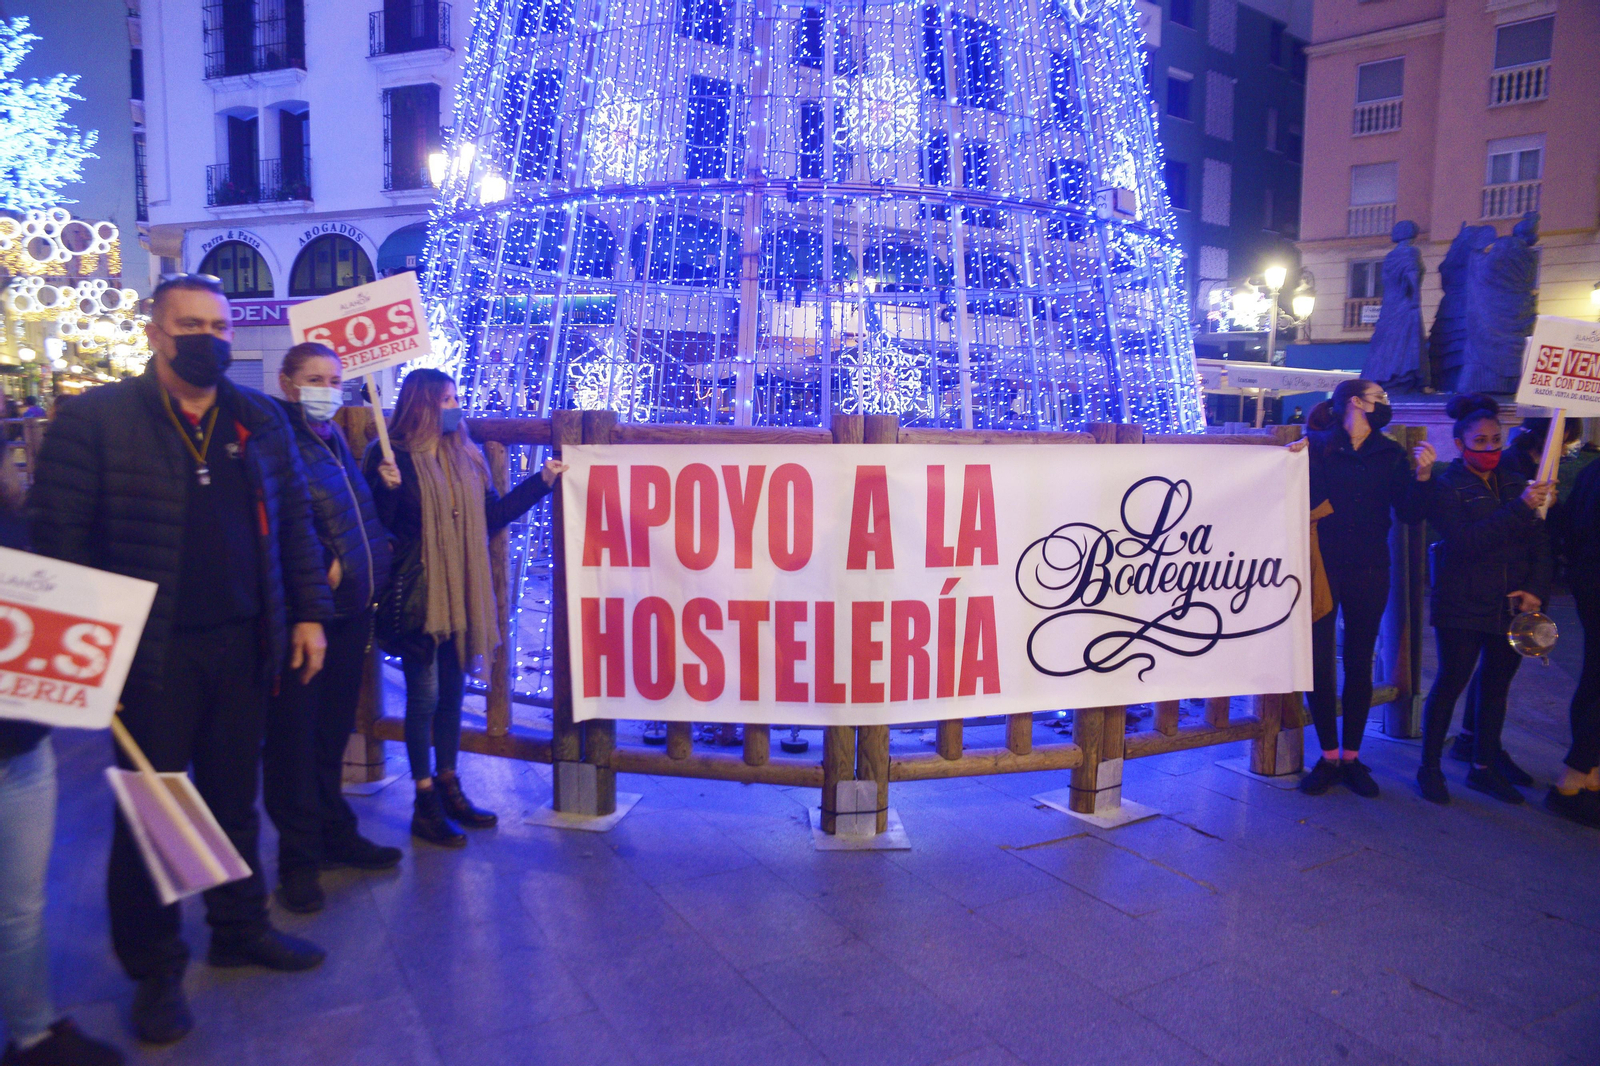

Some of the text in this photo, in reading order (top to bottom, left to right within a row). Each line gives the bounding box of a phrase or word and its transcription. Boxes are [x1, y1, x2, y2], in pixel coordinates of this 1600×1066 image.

[201, 230, 261, 253] Parra & Parra
[298, 223, 364, 247] ABOGADOS
[341, 337, 420, 369] STELERIA
[1537, 347, 1564, 373] SE
[1530, 373, 1552, 387] BAR
[1555, 376, 1576, 390] CON
[582, 463, 999, 572] APOYO A LA
[1115, 476, 1213, 558] La
[1015, 522, 1302, 625] Bodeguiya
[581, 577, 1001, 704] HOSTELERÍA
